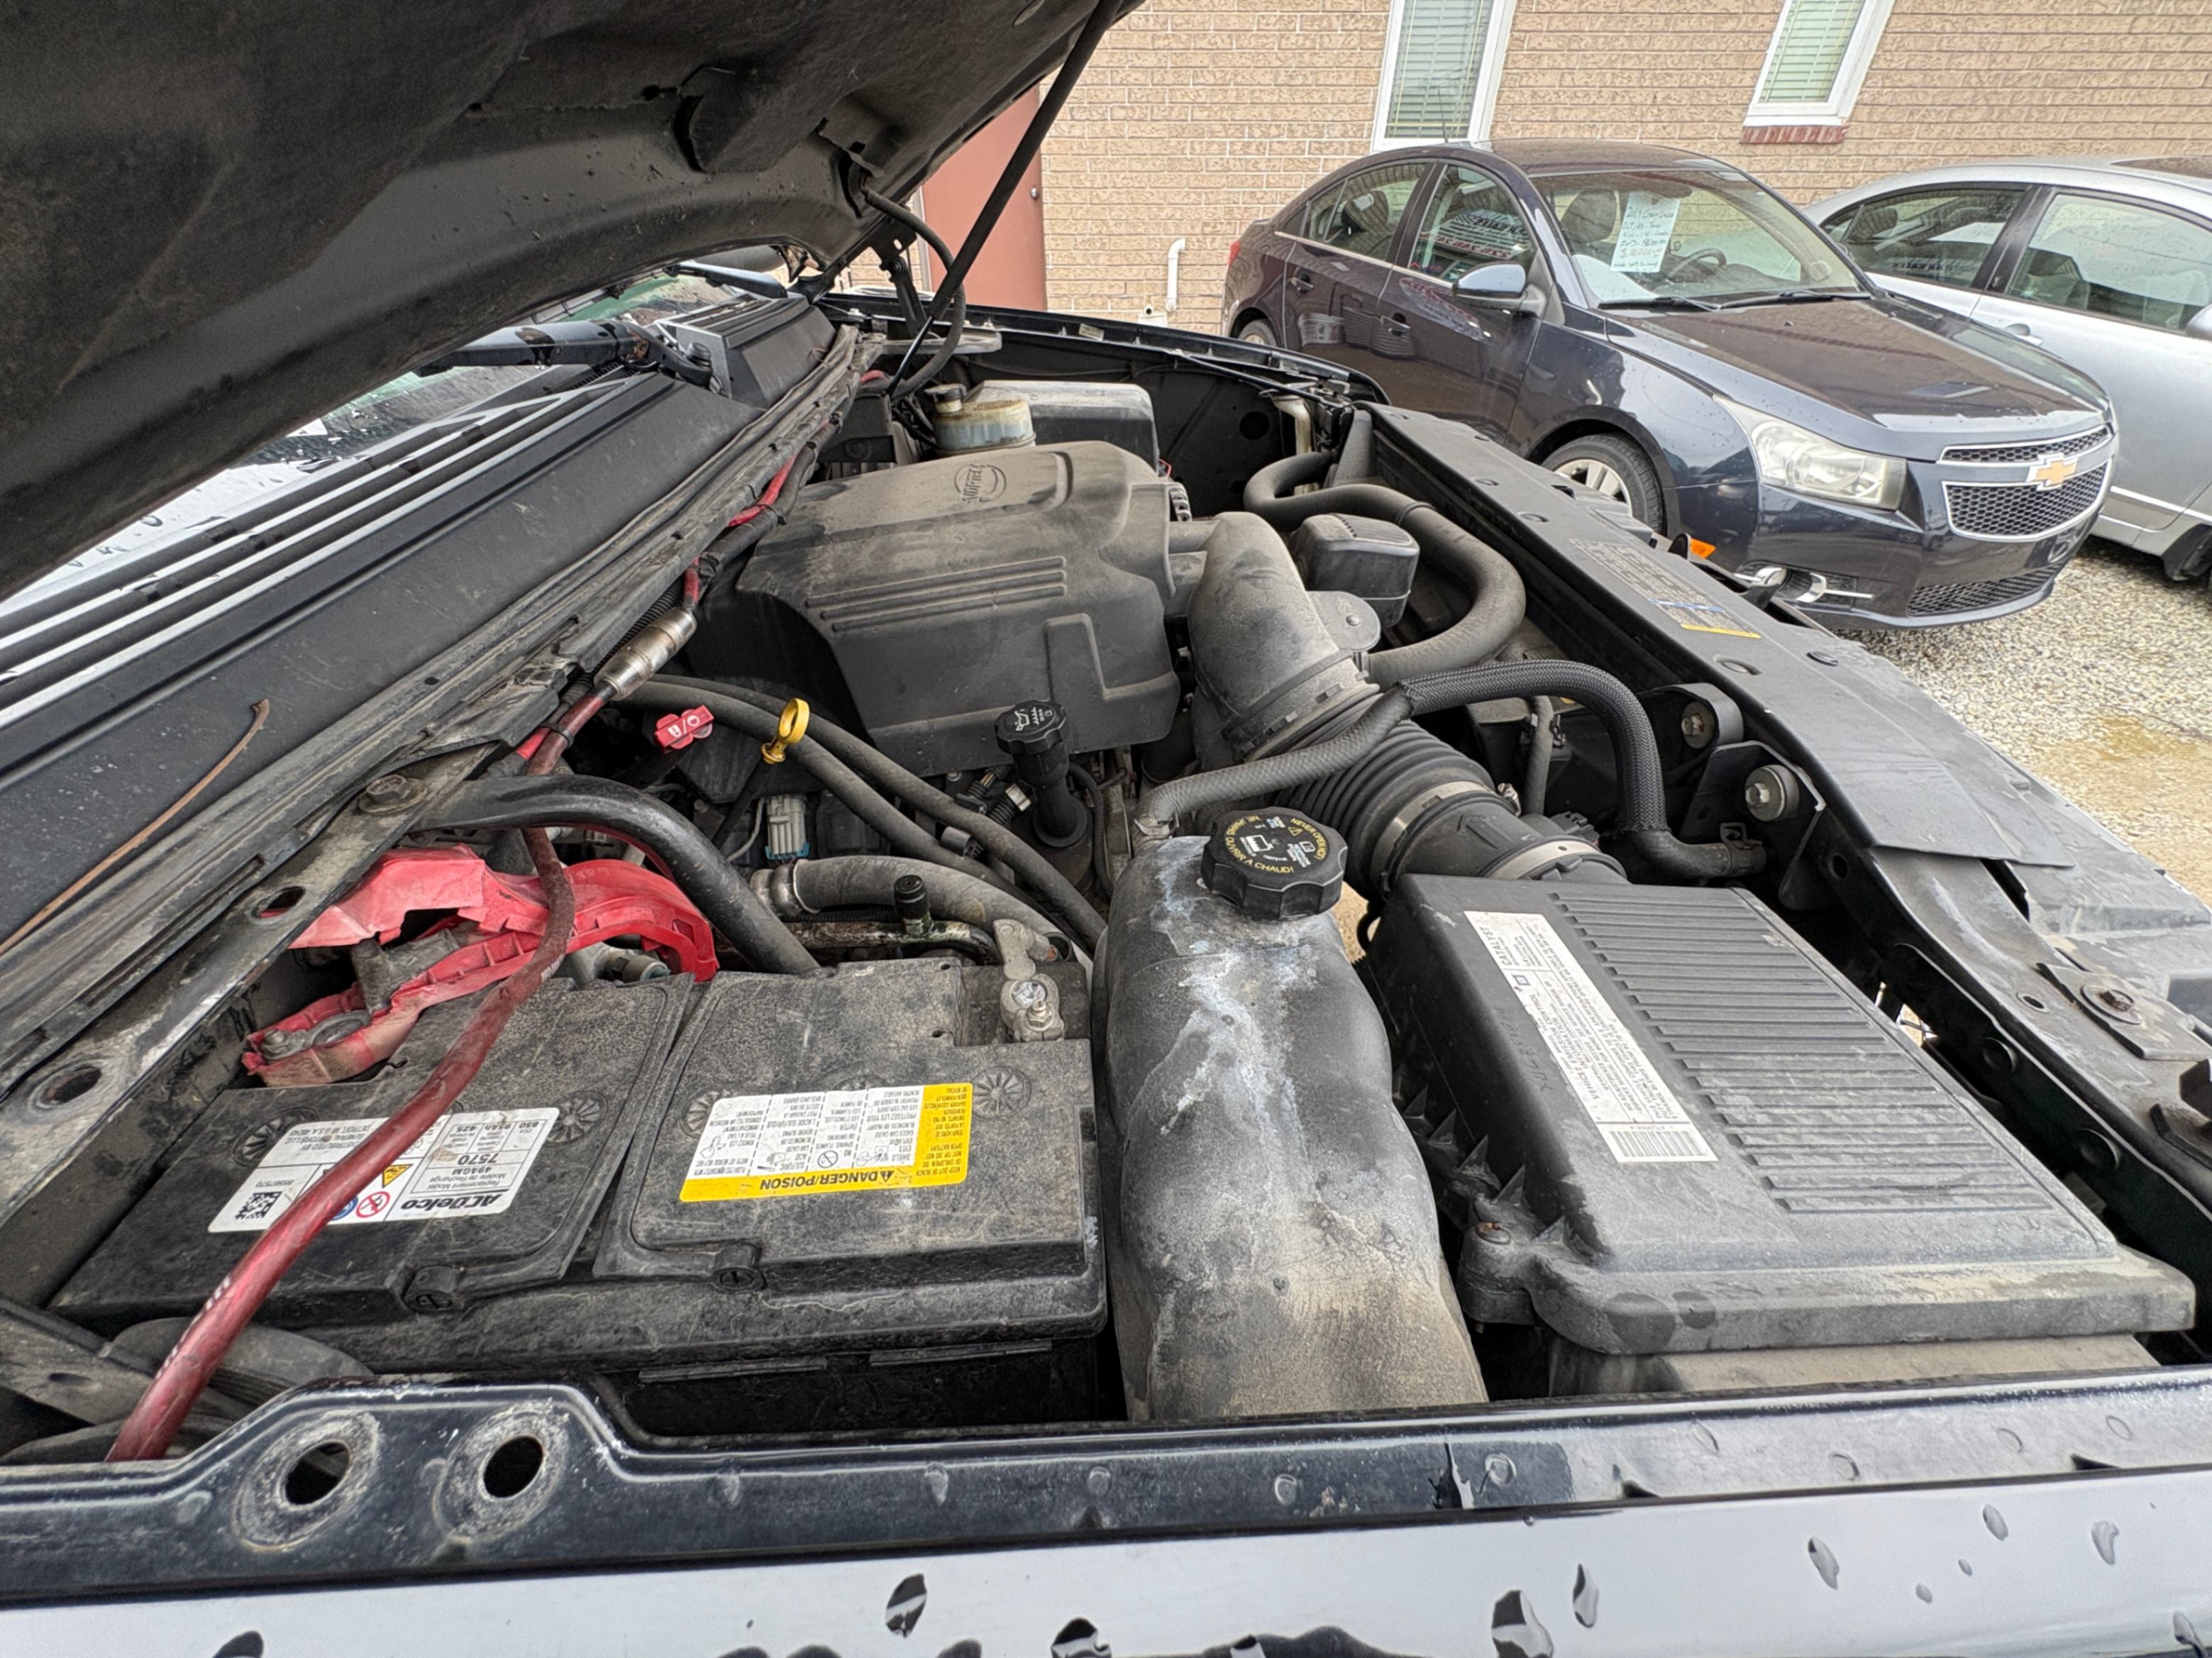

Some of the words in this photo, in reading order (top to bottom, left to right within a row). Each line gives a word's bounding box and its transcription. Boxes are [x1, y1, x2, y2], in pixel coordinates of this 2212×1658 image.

[1226, 818, 1247, 836] JAMAIS
[1290, 818, 1317, 834] NEVER
[1312, 831, 1327, 847] OPEN
[1226, 837, 1246, 861] OUVRIR
[1254, 862, 1295, 873] CHAUD!
[1478, 926, 1513, 966] CATALYST
[1526, 993, 1554, 1025] CONTROL
[1547, 1027, 1578, 1063] EMISSION
[1549, 1017, 1590, 1068] INFORMATION
[1572, 1066, 1602, 1100] VEHICLE
[866, 1113, 880, 1122] YEUX
[330, 1132, 366, 1142] GENERAL
[455, 1152, 501, 1165] 7570
[778, 1161, 805, 1171] SULFURIC
[890, 1152, 911, 1162] SHIELD
[450, 1179, 501, 1189] Replacement
[758, 1171, 878, 1189] DANGER/POISON
[400, 1193, 500, 1212] ACDelco
